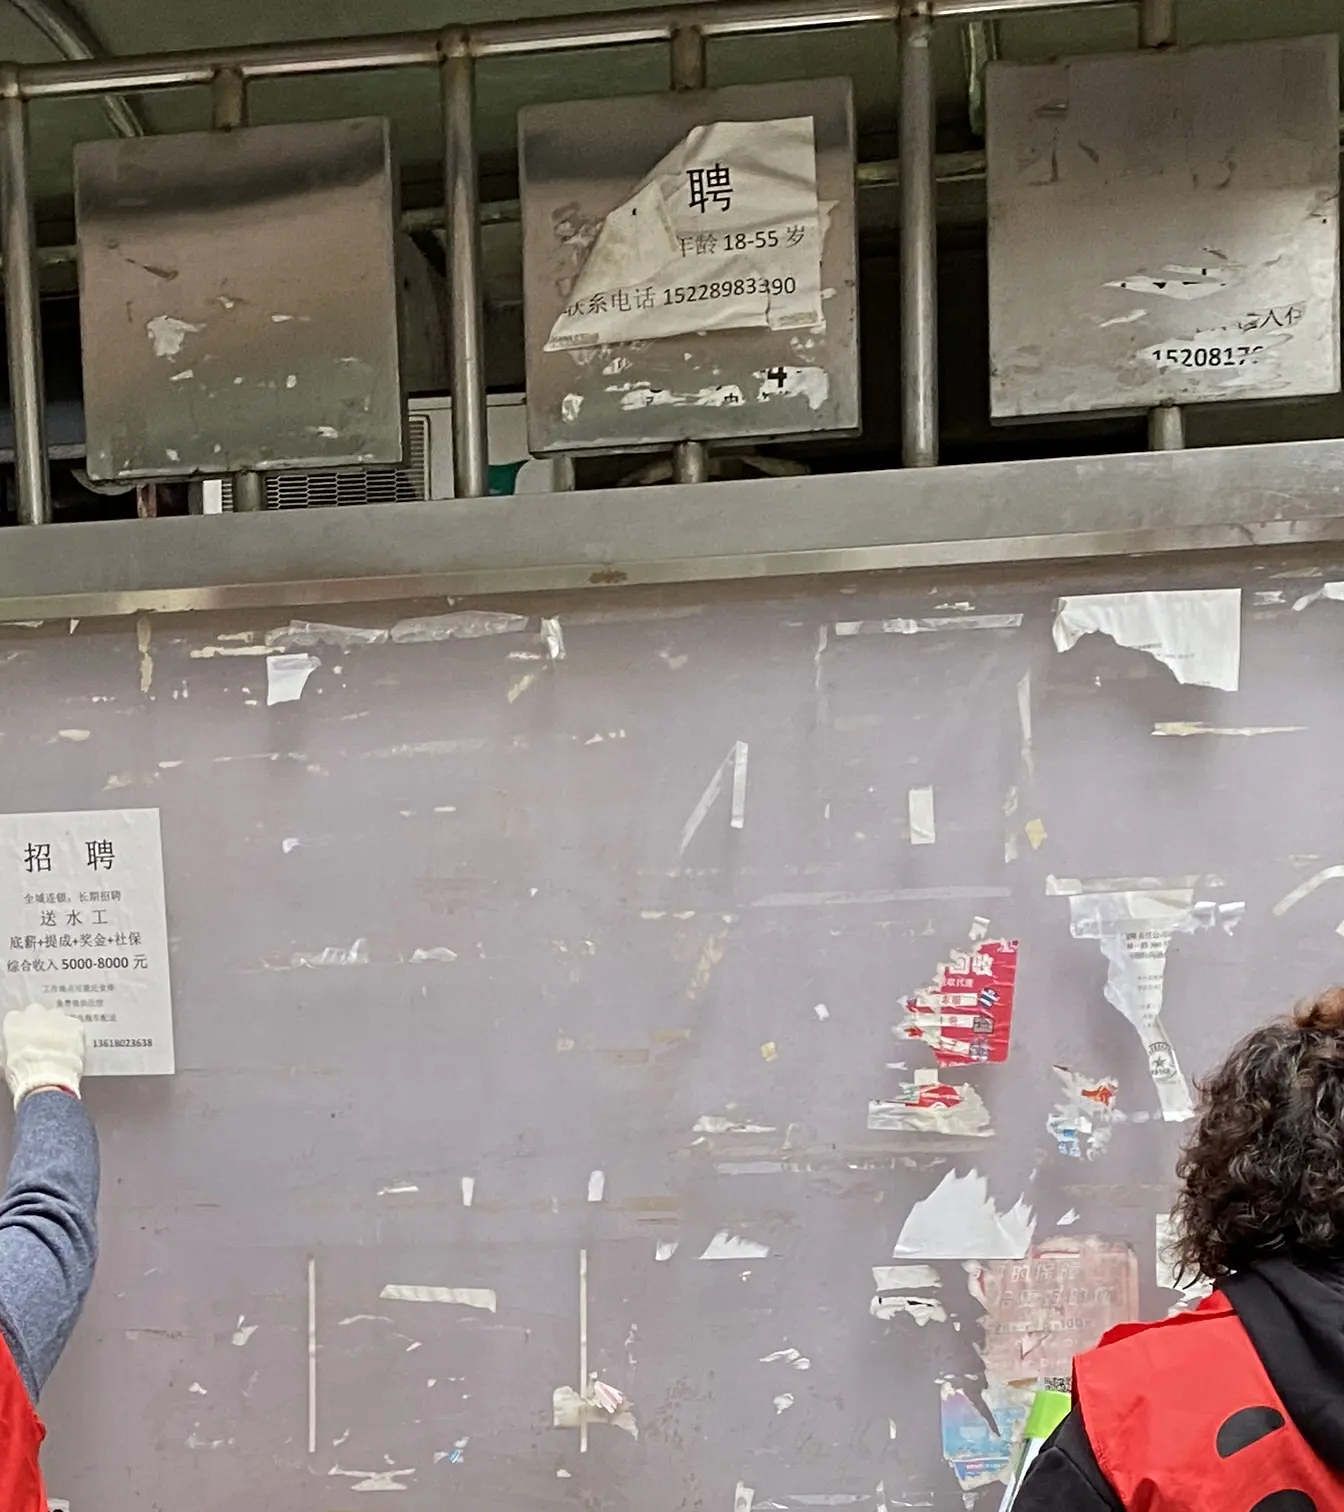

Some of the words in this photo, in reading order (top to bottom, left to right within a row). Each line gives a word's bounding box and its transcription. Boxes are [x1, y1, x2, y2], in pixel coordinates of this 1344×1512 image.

[686, 162, 734, 214] 聘
[723, 229, 780, 252] 18-55
[785, 224, 807, 250] 岁
[23, 838, 116, 873] 招聘
[40, 908, 109, 928] 送水工
[10, 931, 143, 951] 底薪+提成+奖金+社保
[7, 958, 58, 974] 综合收入
[61, 956, 130, 971] 5000-8000
[132, 953, 149, 971] 元
